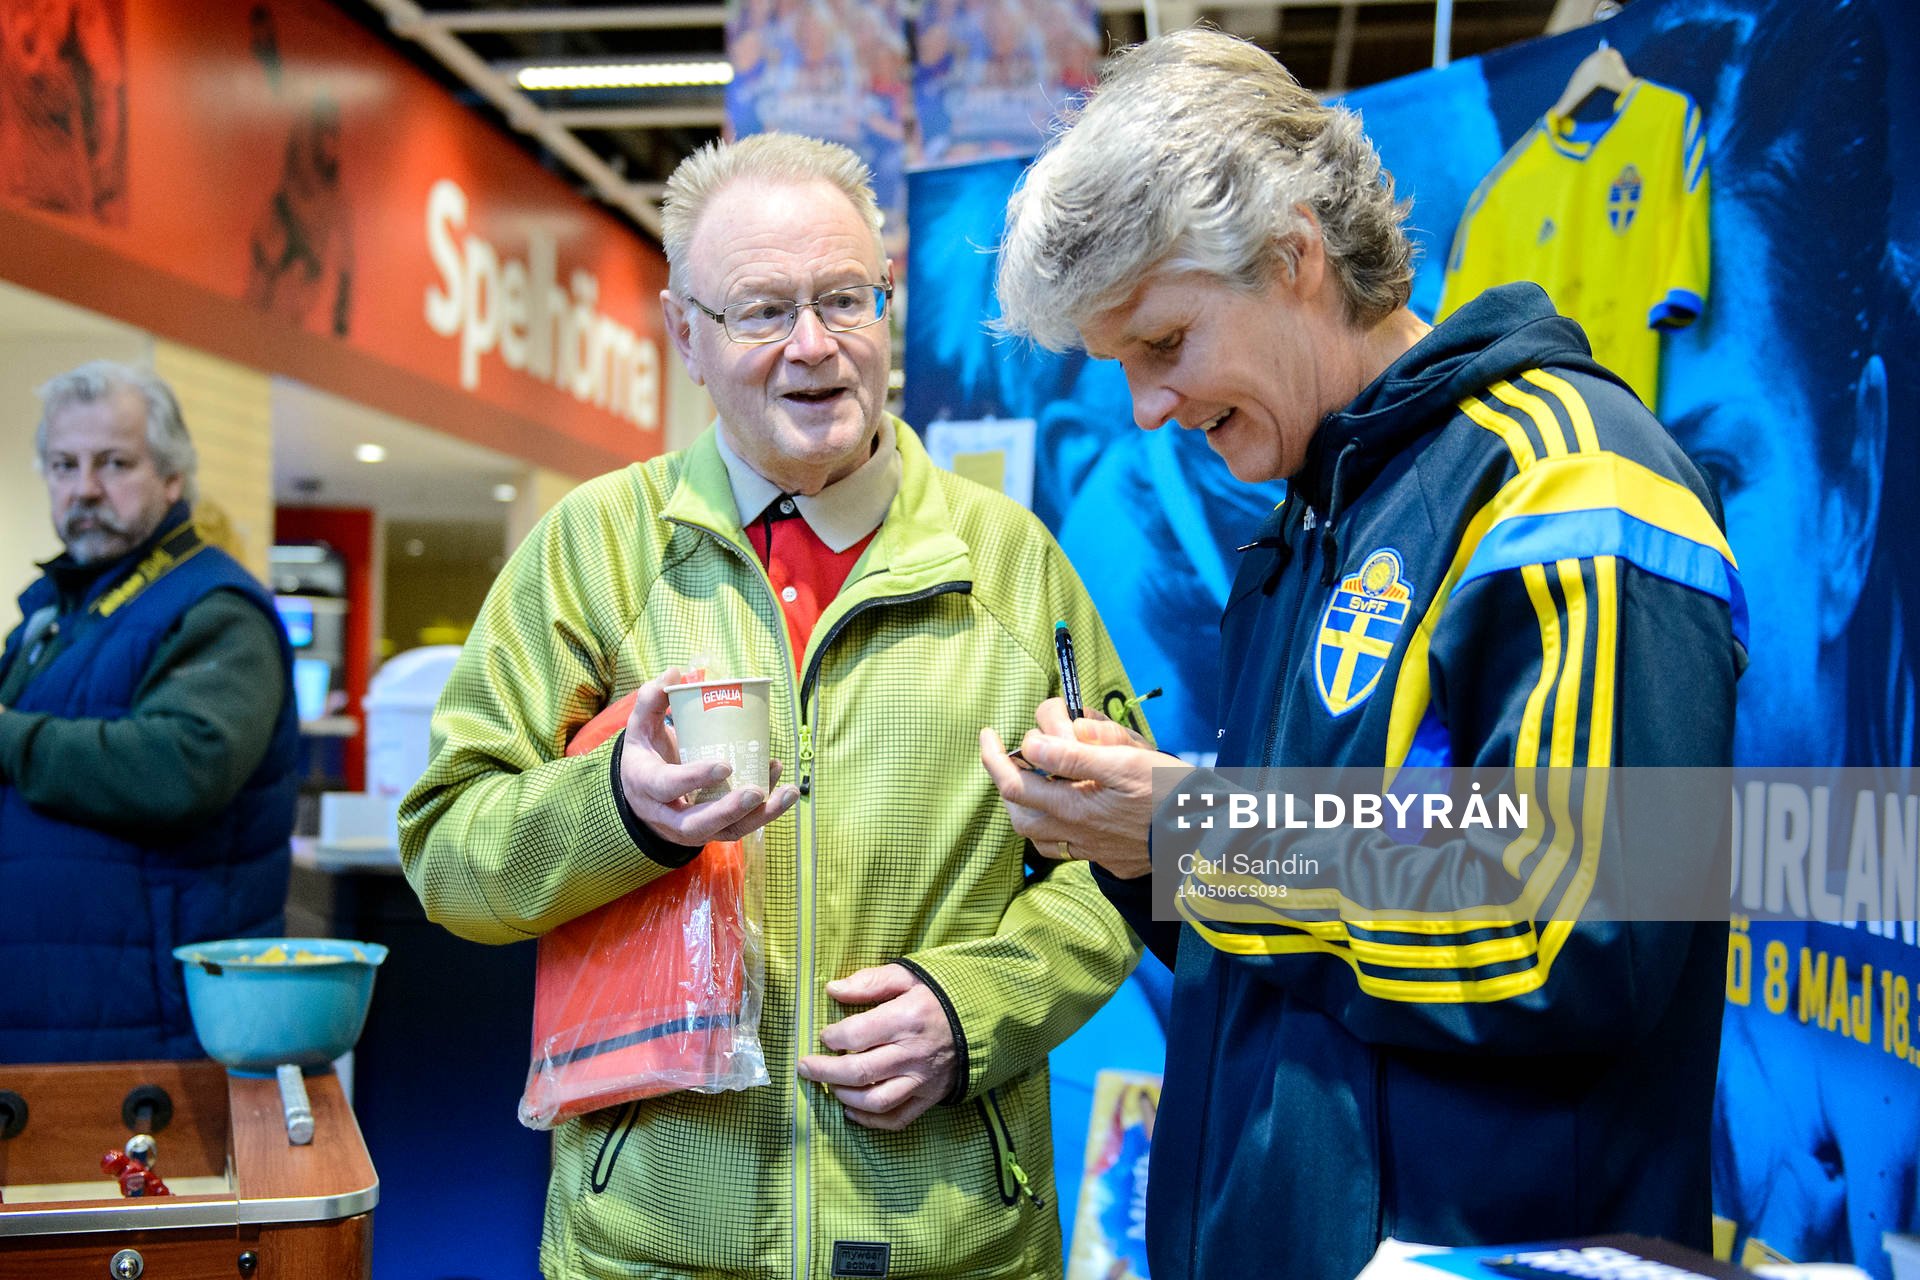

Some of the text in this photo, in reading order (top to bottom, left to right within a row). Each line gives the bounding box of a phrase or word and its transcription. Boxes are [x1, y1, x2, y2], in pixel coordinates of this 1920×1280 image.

[425, 179, 660, 431] Spelhörna
[1349, 596, 1389, 614] SvFF
[703, 689, 741, 703] GEVALIA
[1730, 780, 1920, 948] IRLAN
[1763, 939, 1789, 1015] 8
[1798, 946, 1873, 1044] MAJ
[1880, 969, 1920, 1069] 18.
